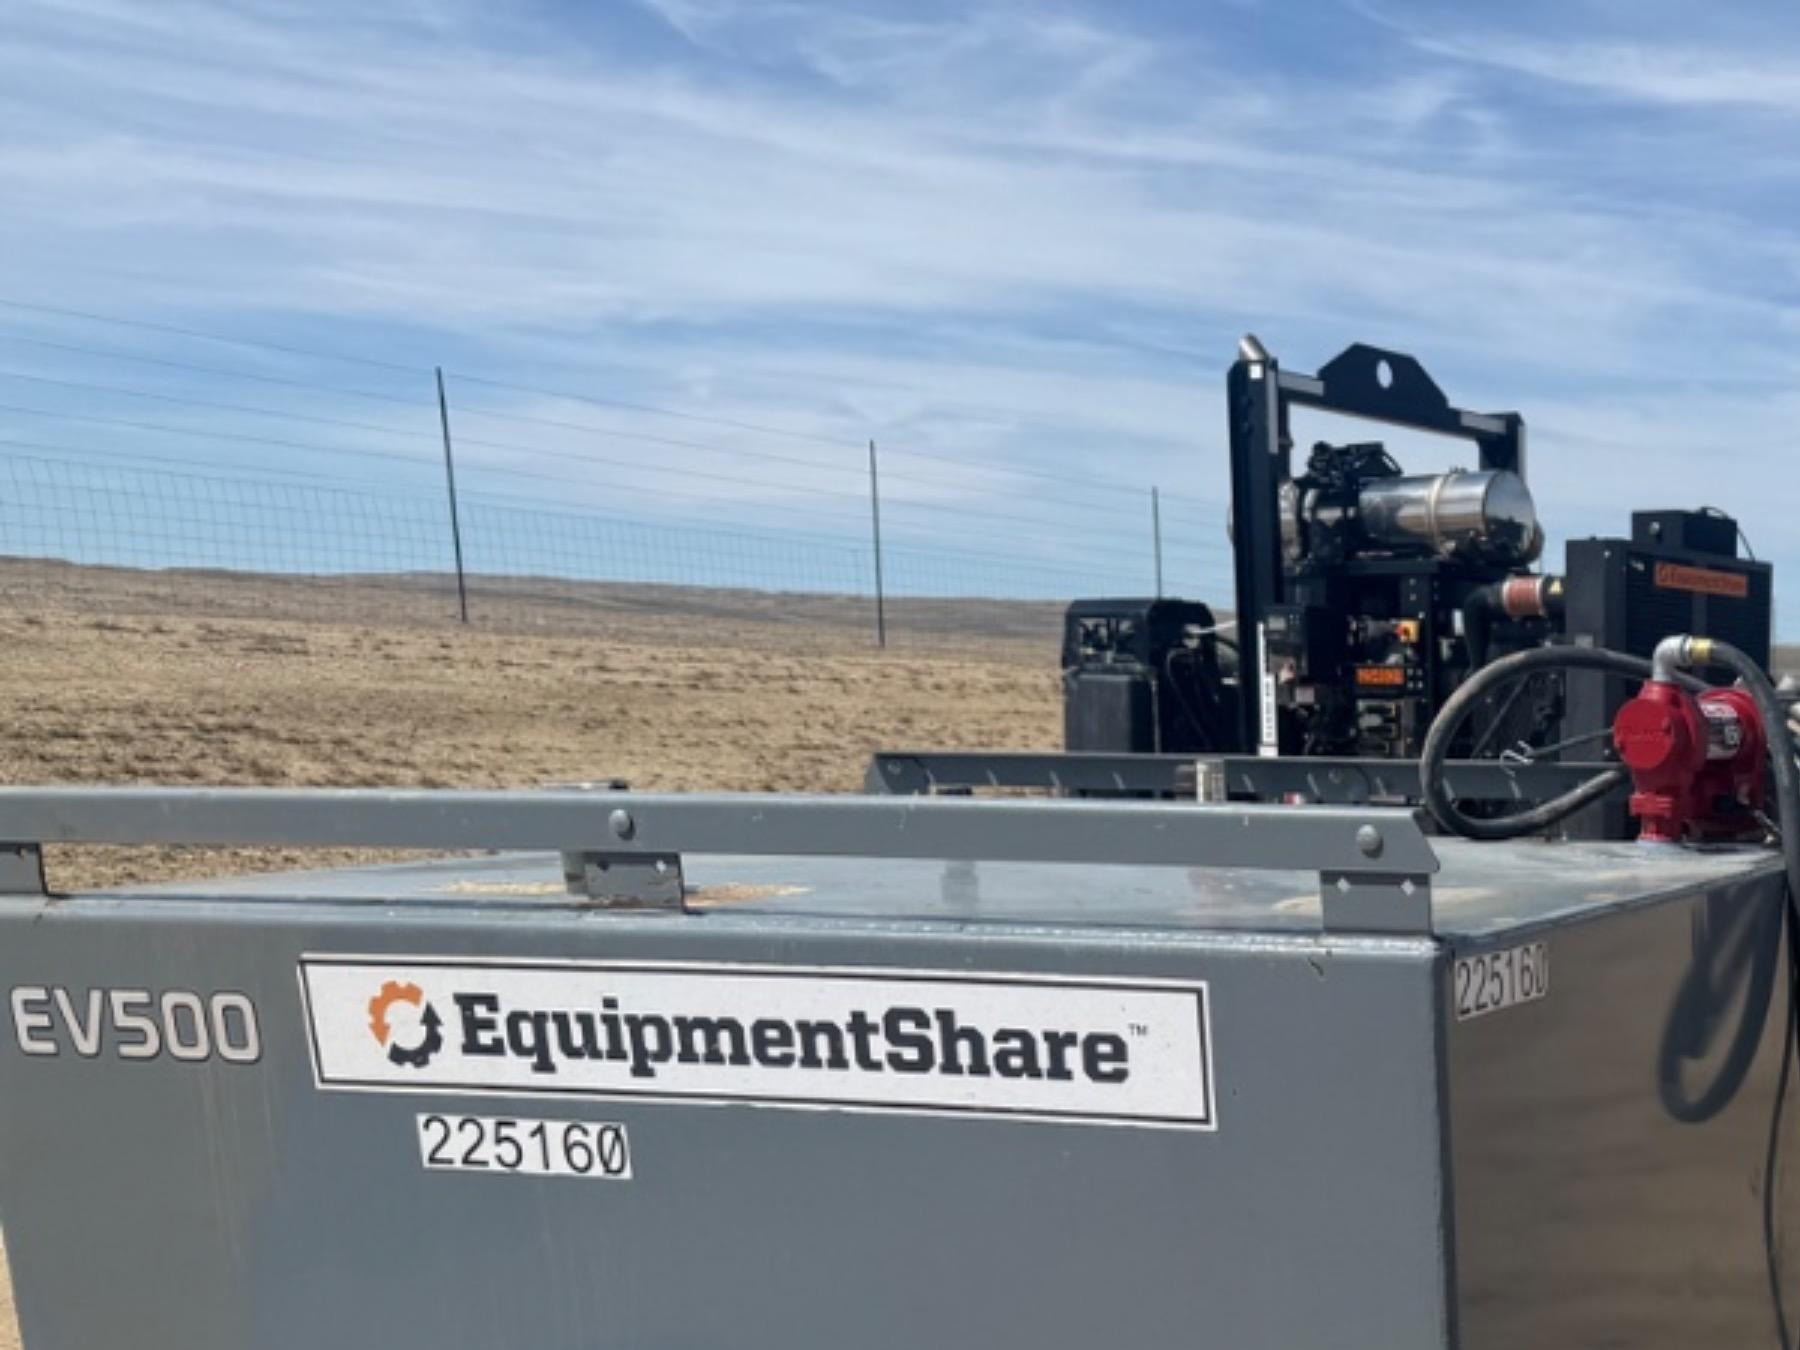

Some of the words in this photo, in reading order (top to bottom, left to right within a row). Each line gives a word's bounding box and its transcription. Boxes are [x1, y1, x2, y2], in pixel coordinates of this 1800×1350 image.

[1456, 942, 1546, 1016] 225160
[10, 984, 262, 1063] EV500
[421, 1115, 627, 1174] 225160
